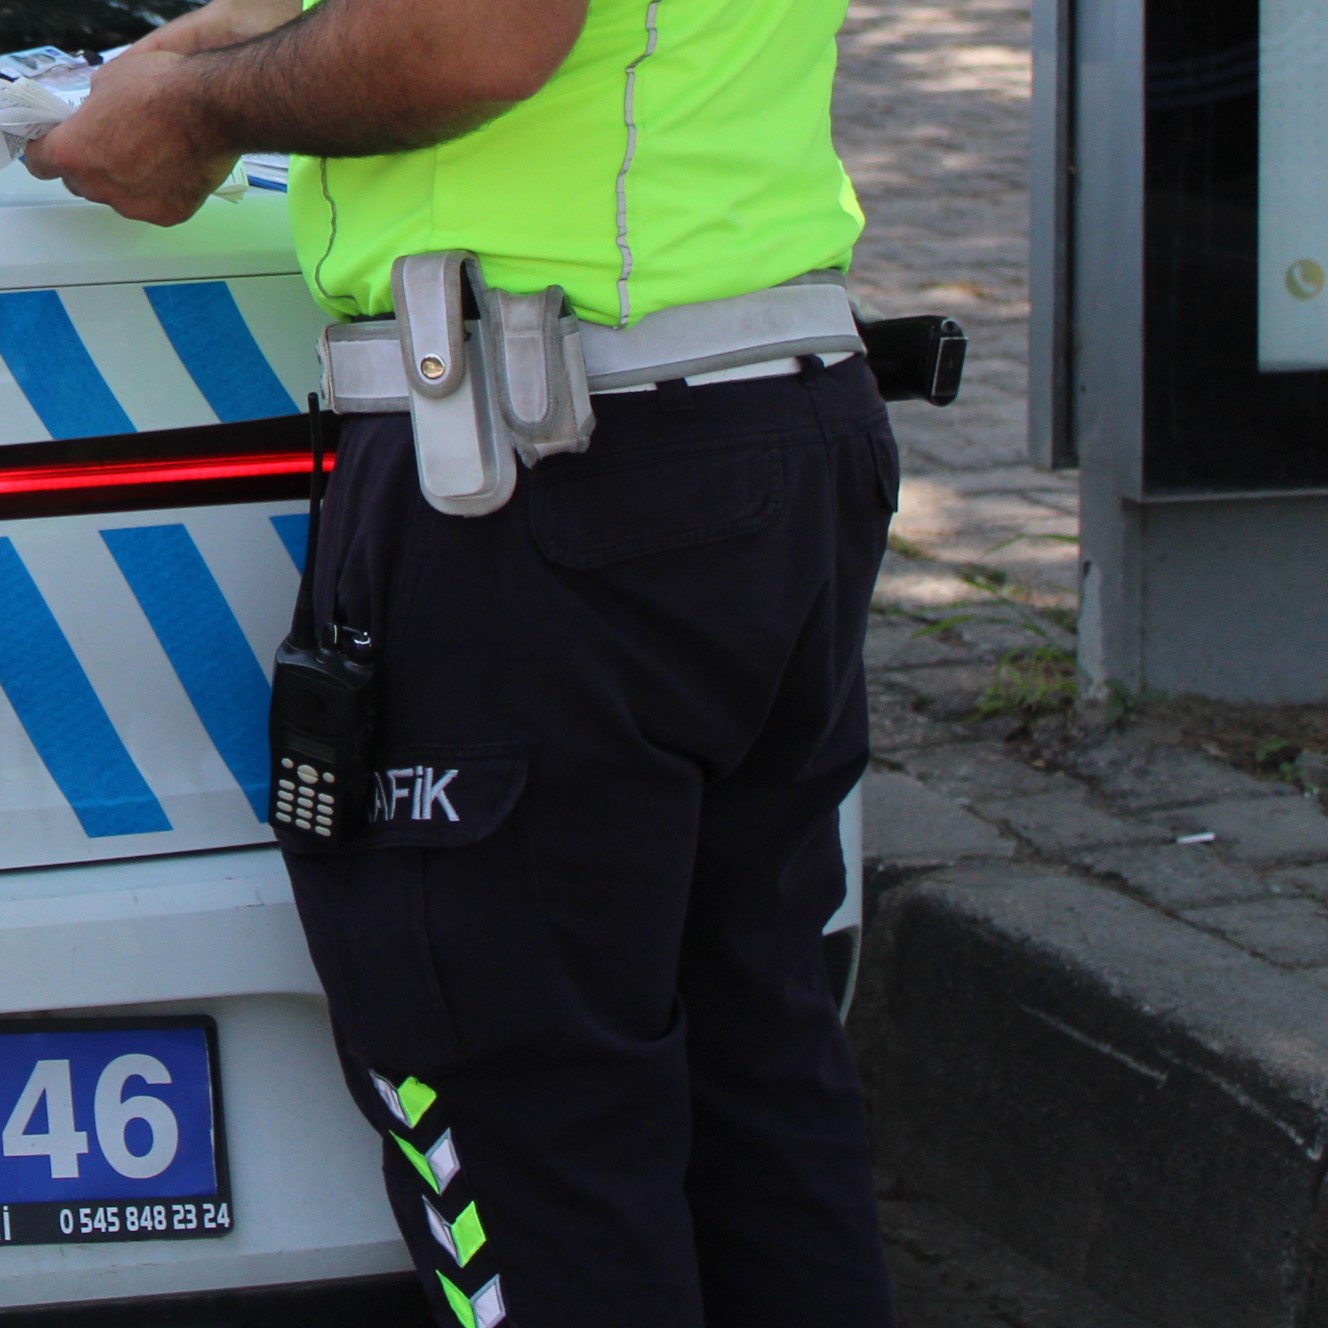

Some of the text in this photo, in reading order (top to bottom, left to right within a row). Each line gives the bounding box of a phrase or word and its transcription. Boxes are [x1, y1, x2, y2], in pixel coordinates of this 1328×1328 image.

[58, 1208, 74, 1235] 0
[80, 1205, 119, 1234] 545
[125, 1204, 167, 1232] 848
[172, 1202, 198, 1230] 23
[202, 1202, 231, 1229] 24
